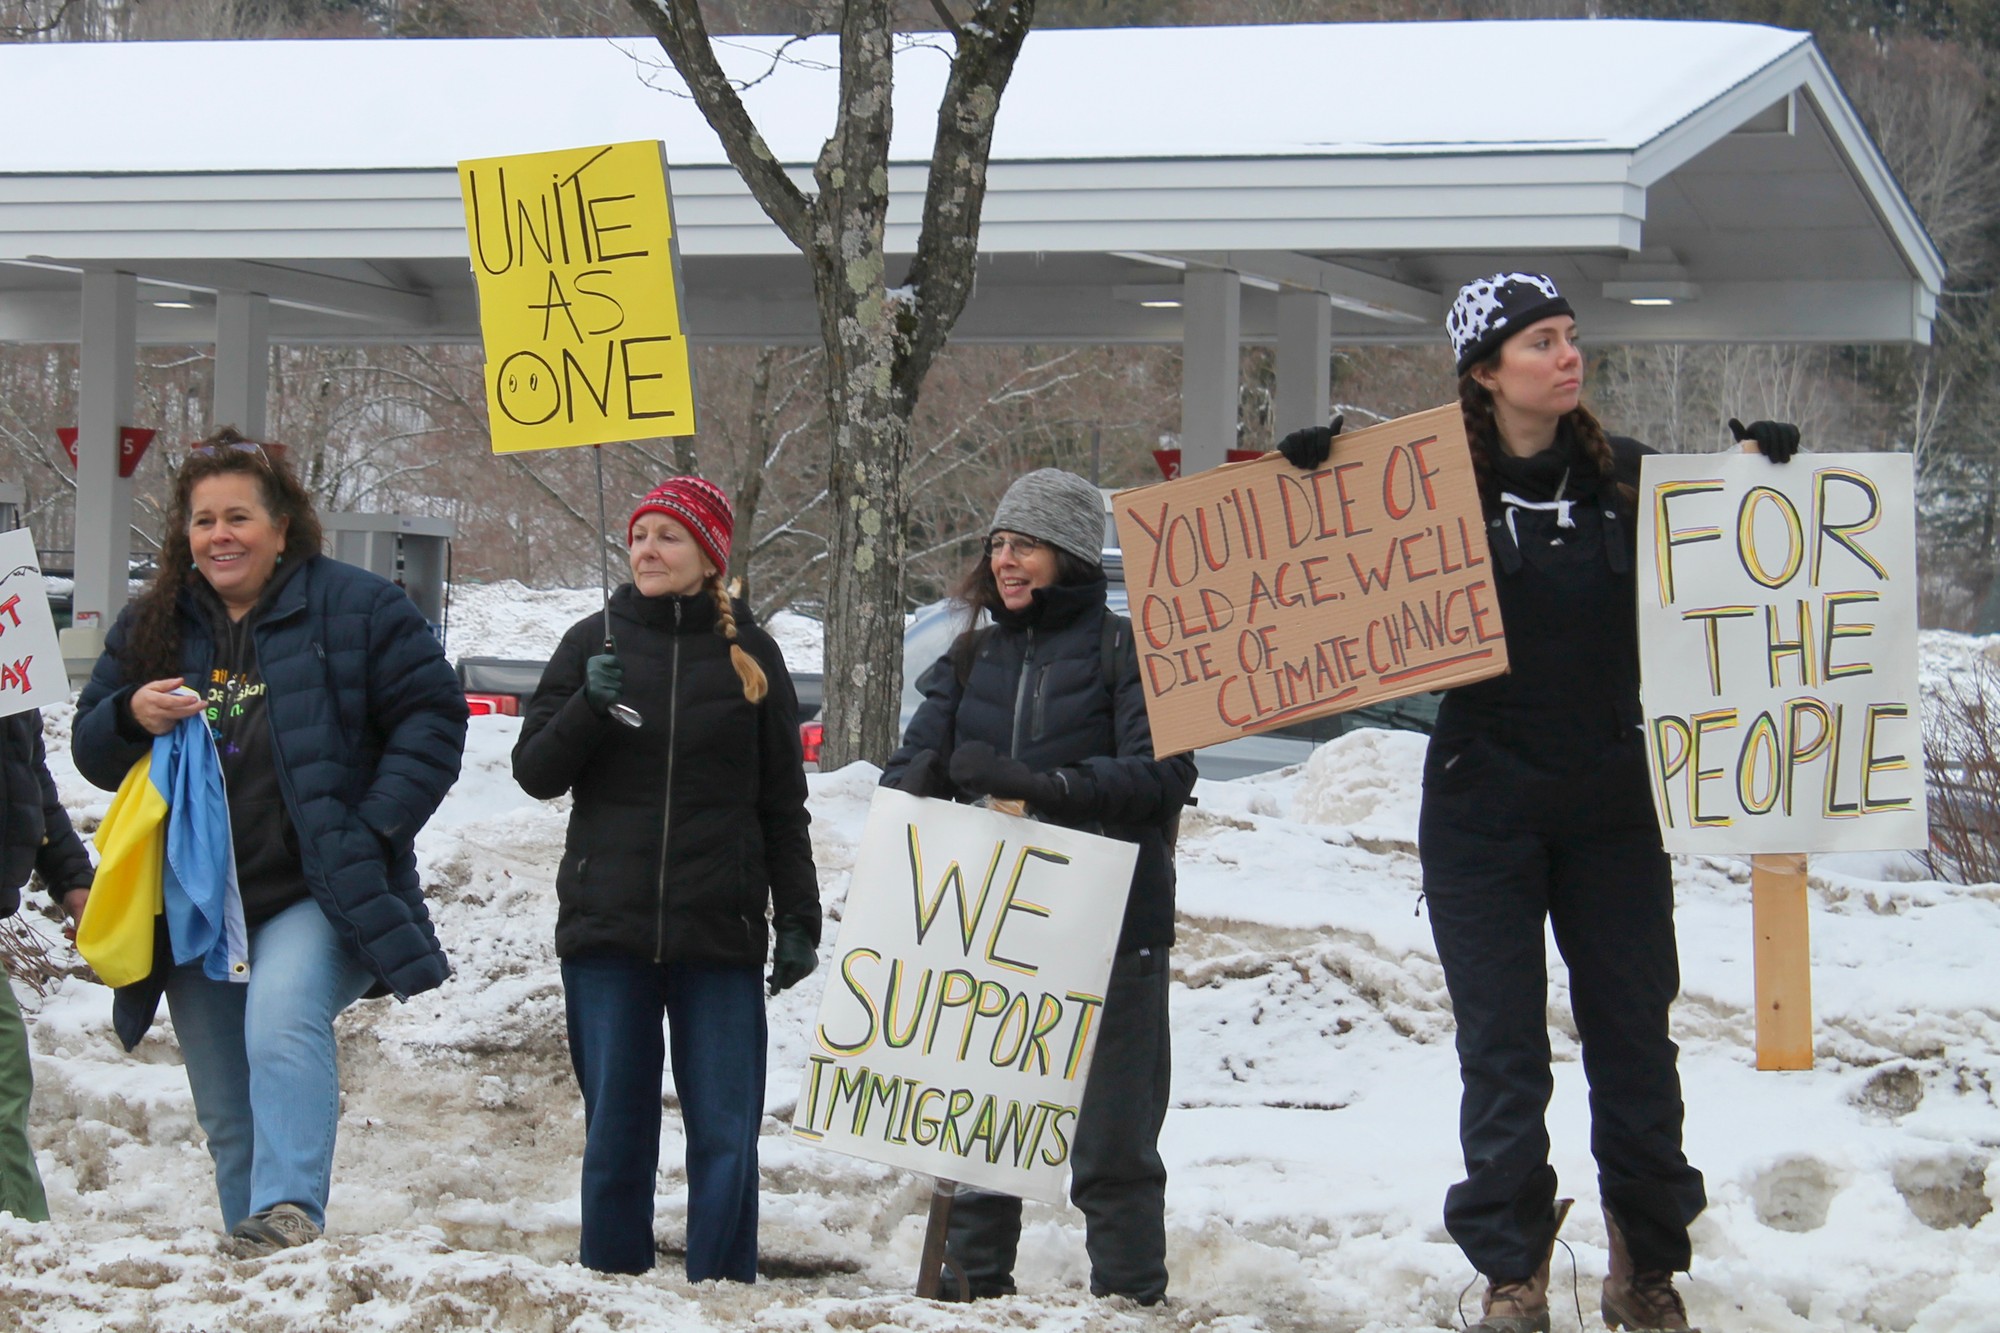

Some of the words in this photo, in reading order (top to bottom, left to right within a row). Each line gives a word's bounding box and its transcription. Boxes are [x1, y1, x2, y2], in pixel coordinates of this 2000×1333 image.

[528, 269, 625, 344] AS
[496, 335, 675, 426] ONE
[123, 438, 134, 455] 5
[1169, 463, 1179, 479] 2
[1276, 461, 1373, 549] DIE
[1382, 435, 1441, 521] OF
[1142, 588, 1235, 650] OLD
[1347, 516, 1485, 595] WE'LL
[1653, 467, 1890, 609] FOR
[0, 593, 21, 637] T
[1145, 642, 1222, 698] DIE
[1237, 625, 1280, 674] OF
[1681, 590, 1882, 697] THE
[0, 655, 34, 694] AY
[1648, 696, 1916, 829] PEOPLE
[907, 823, 1072, 977] WE
[815, 947, 1103, 1081] SUPPORT
[791, 1054, 1079, 1171] IMMIGRANTS
